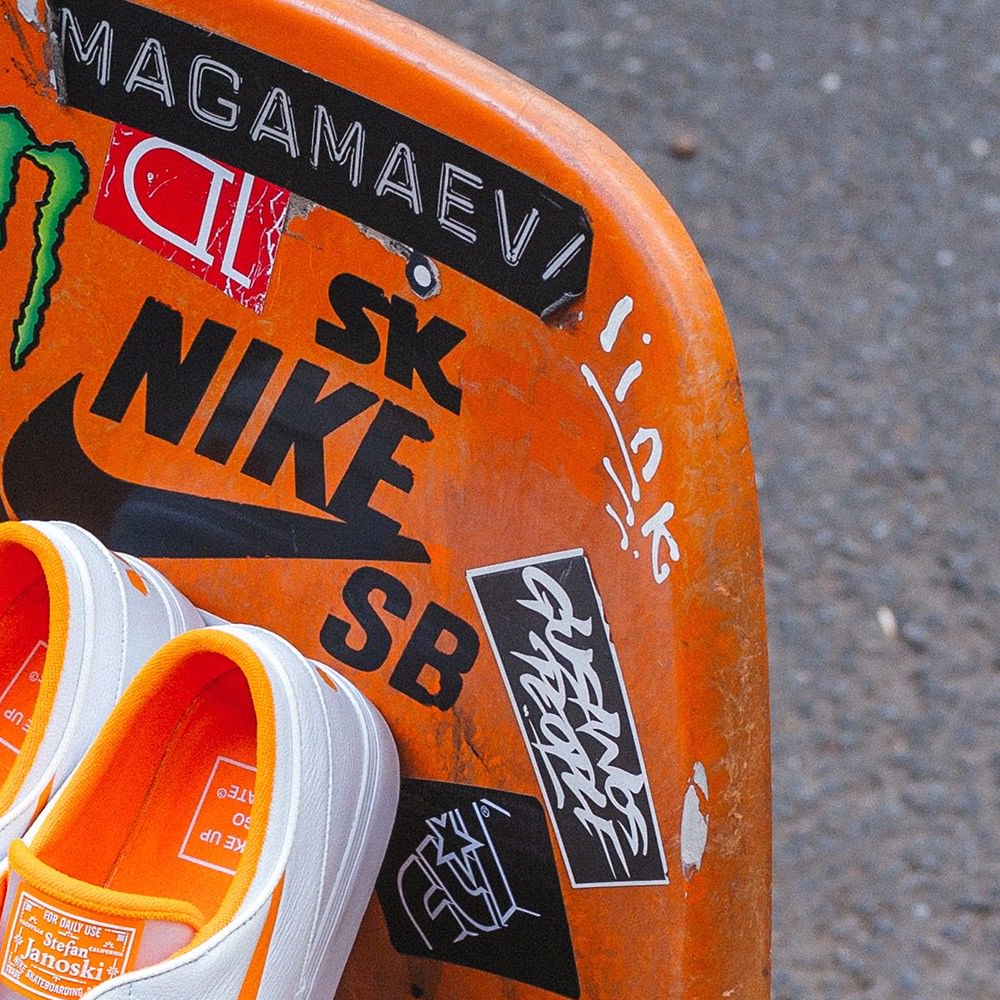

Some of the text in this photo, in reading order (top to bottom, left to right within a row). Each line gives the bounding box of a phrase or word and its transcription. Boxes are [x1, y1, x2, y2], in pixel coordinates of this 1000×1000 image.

[315, 272, 467, 416] SK
[89, 296, 434, 528] NIKE
[318, 566, 482, 711] SB
[200, 830, 221, 845] UP
[44, 911, 101, 937] FOR DAILY USE
[22, 939, 104, 980] Janoski
[44, 933, 88, 957] Stefan
